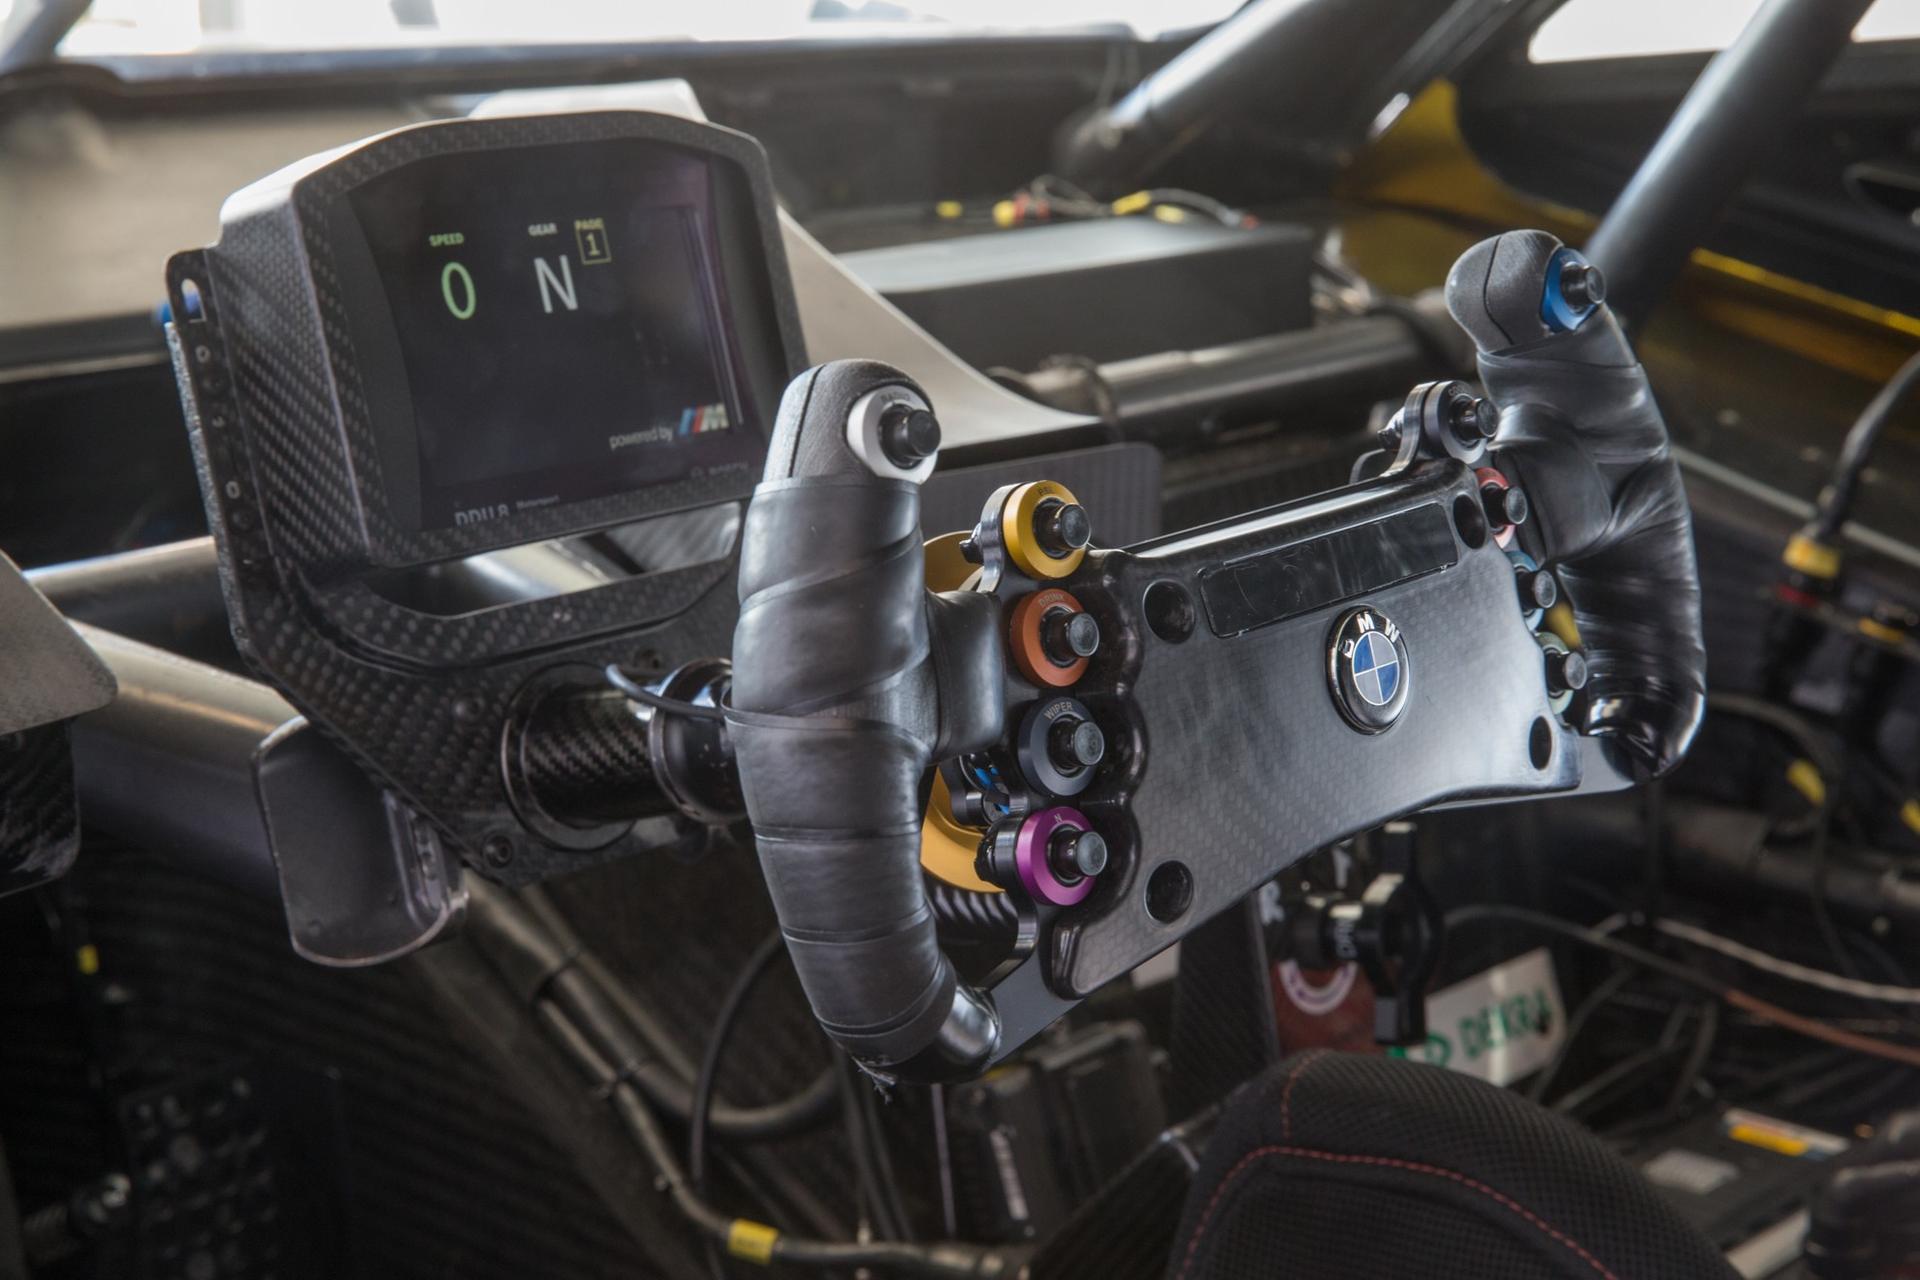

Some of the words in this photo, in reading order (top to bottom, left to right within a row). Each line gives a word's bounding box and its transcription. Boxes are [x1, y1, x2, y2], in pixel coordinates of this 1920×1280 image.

[429, 233, 464, 247] SPEED
[528, 223, 557, 236] GEAR
[585, 232, 600, 256] 1
[441, 262, 476, 320] 0
[533, 254, 578, 314] N
[609, 424, 657, 450] powered
[659, 425, 673, 443] by
[1339, 611, 1400, 659] BMW
[1044, 701, 1073, 720] WIPER
